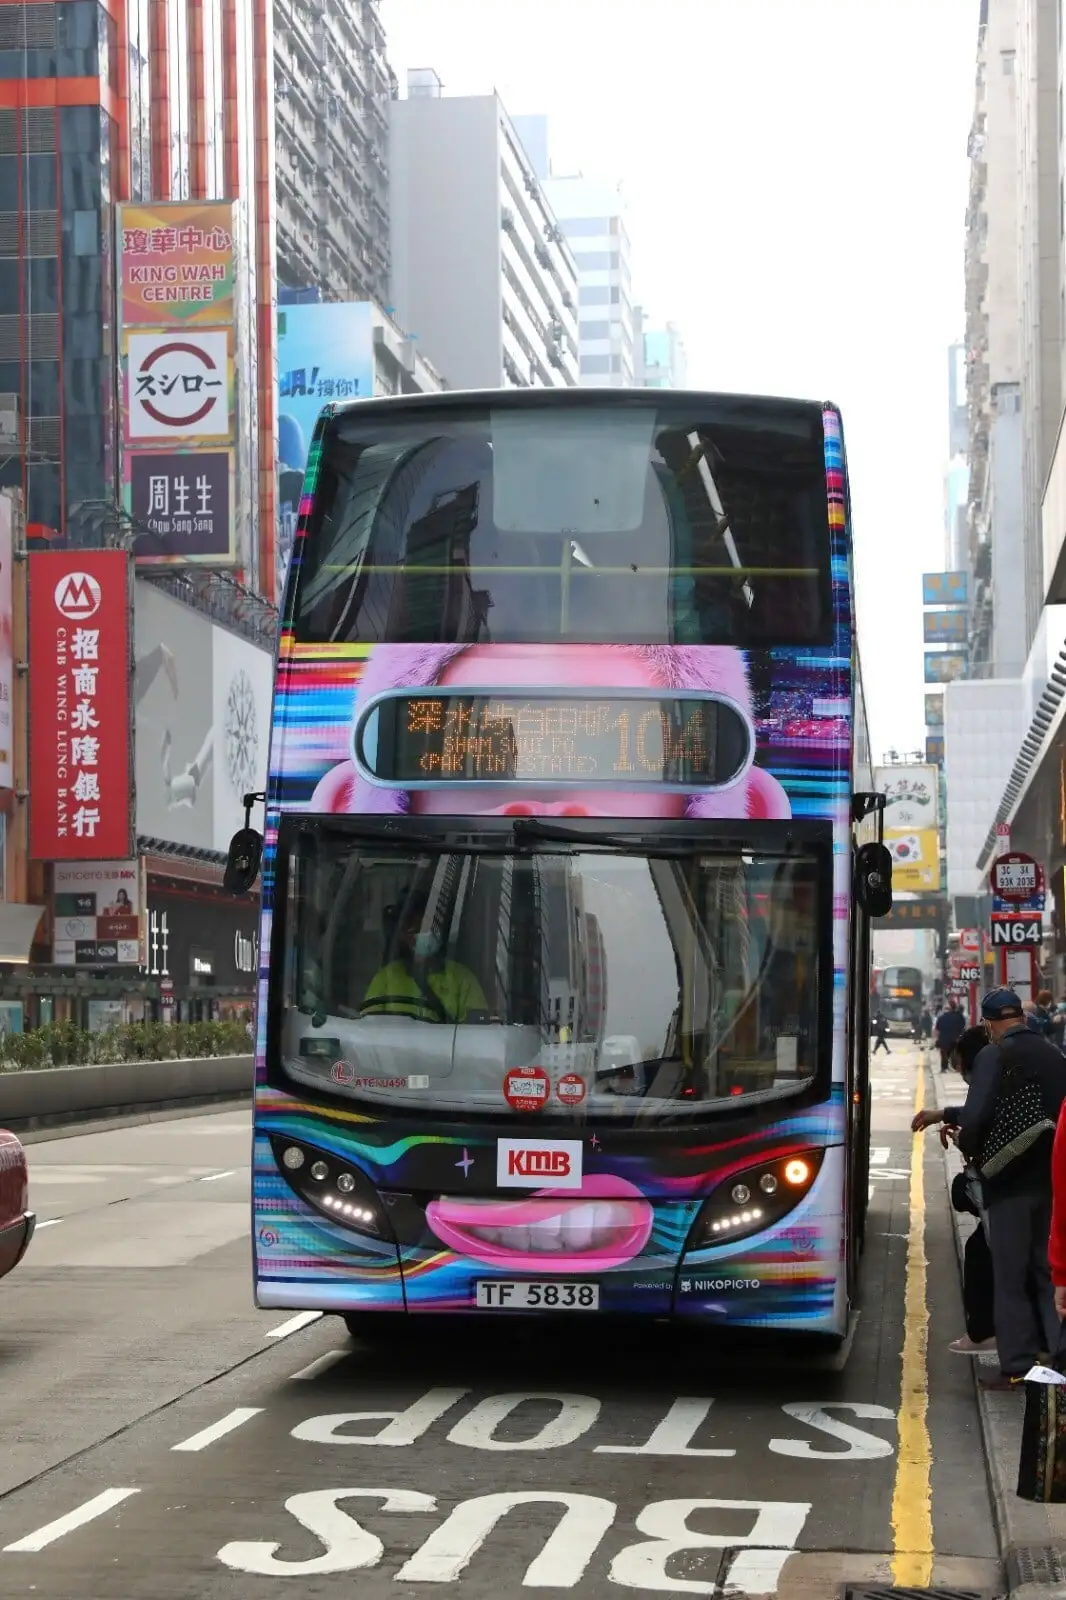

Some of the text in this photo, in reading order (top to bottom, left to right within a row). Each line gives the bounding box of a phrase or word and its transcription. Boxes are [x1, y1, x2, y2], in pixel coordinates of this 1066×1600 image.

[122, 225, 232, 254] 瓊華中心
[129, 264, 226, 283] KING WAH
[142, 284, 213, 303] CENTRE
[134, 372, 223, 397] スシロー
[147, 475, 214, 516] 周生生
[172, 517, 192, 535] Sang
[193, 517, 214, 534] Sang
[56, 627, 68, 838] CMB WING LUNG BANK
[70, 627, 101, 838] 招商永隆銀行
[612, 709, 707, 773] 104
[443, 736, 493, 754] SHAM
[499, 736, 545, 754] SHUI
[471, 753, 507, 772] TIN
[1001, 865, 1011, 875] 3C
[999, 877, 1035, 887] 93K 203E
[994, 922, 1040, 943] N64
[507, 1150, 572, 1177] KMB
[481, 1284, 595, 1307] TF 5838
[695, 1279, 760, 1291] NIKOPICTO
[290, 1386, 897, 1460] STOP
[216, 1487, 813, 1595] BUS
